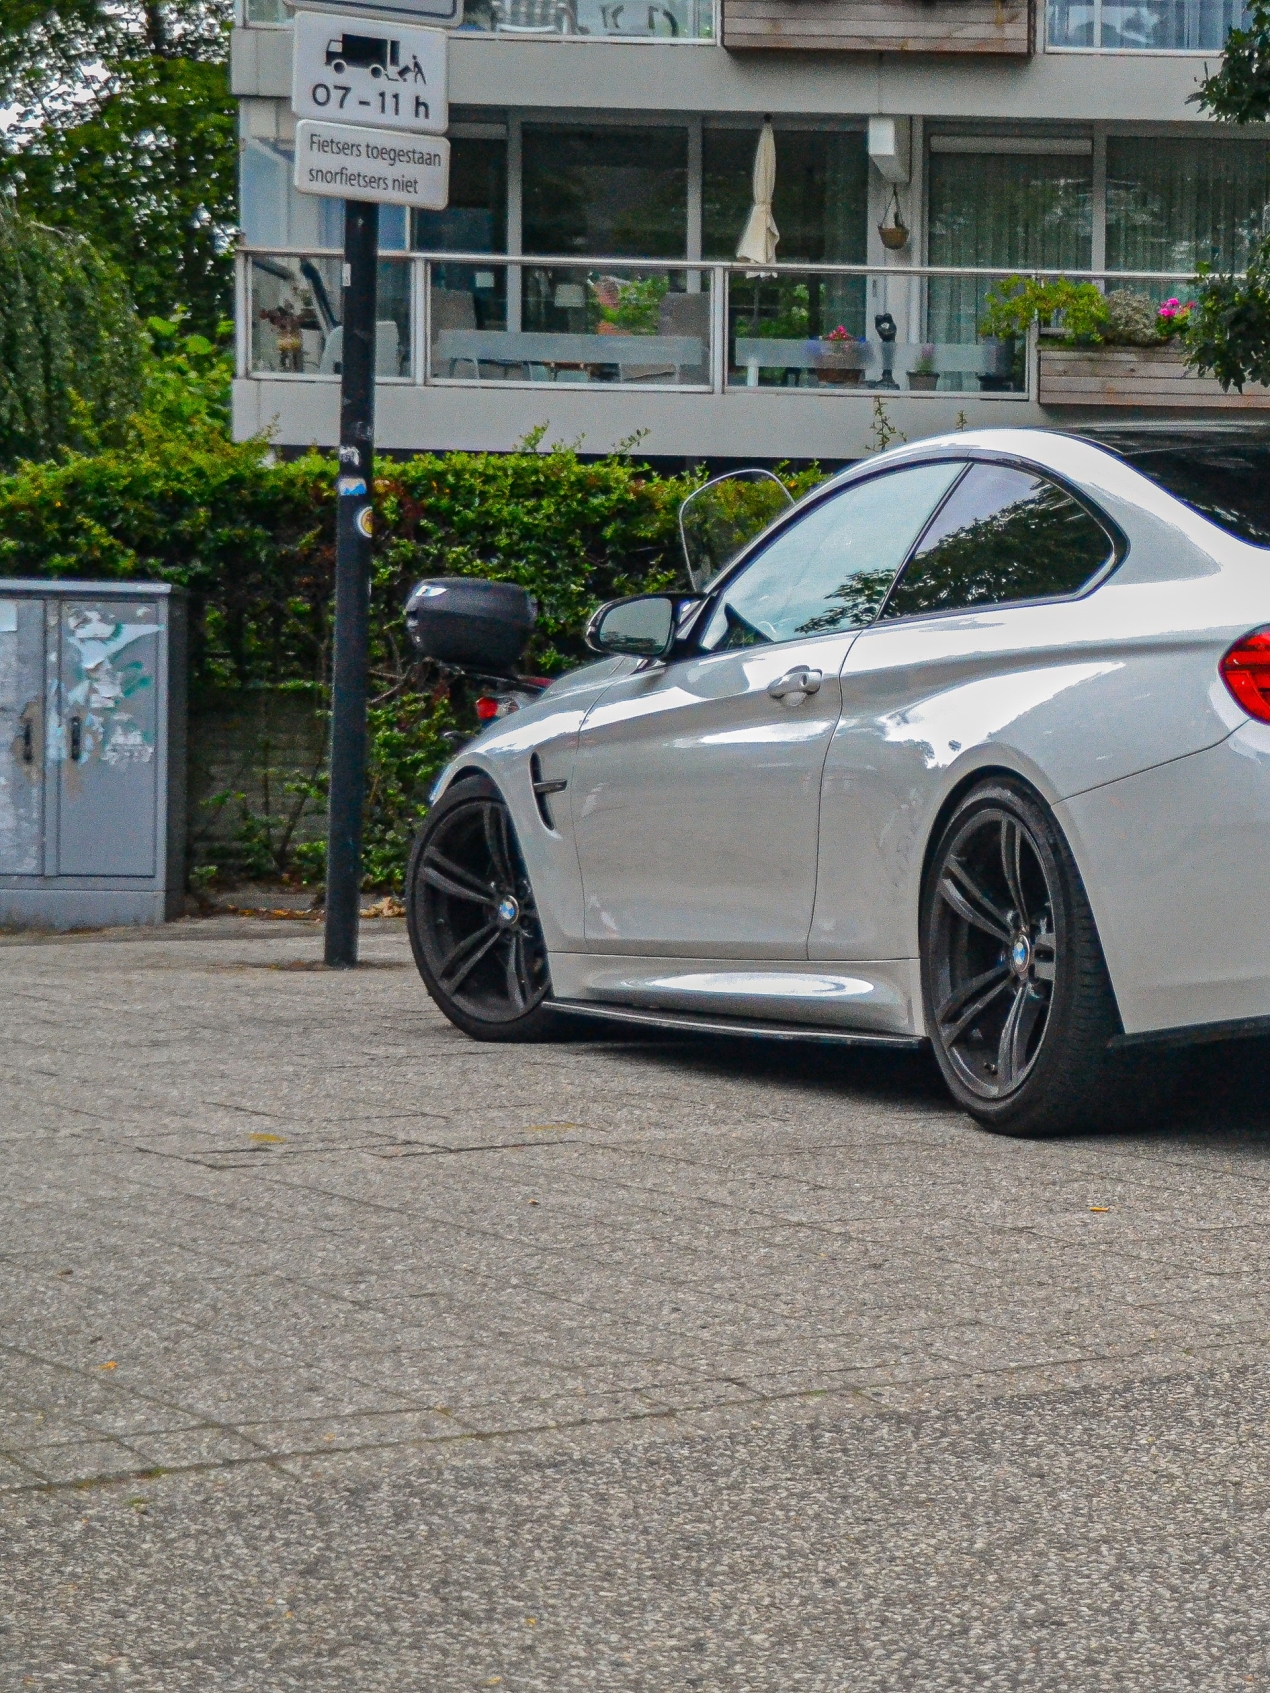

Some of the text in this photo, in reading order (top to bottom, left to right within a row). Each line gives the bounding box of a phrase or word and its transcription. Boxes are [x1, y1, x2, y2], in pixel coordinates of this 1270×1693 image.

[414, 95, 430, 119] h
[309, 134, 442, 167] Fietsers toegestaan
[308, 167, 419, 195] snorfietsers niet
